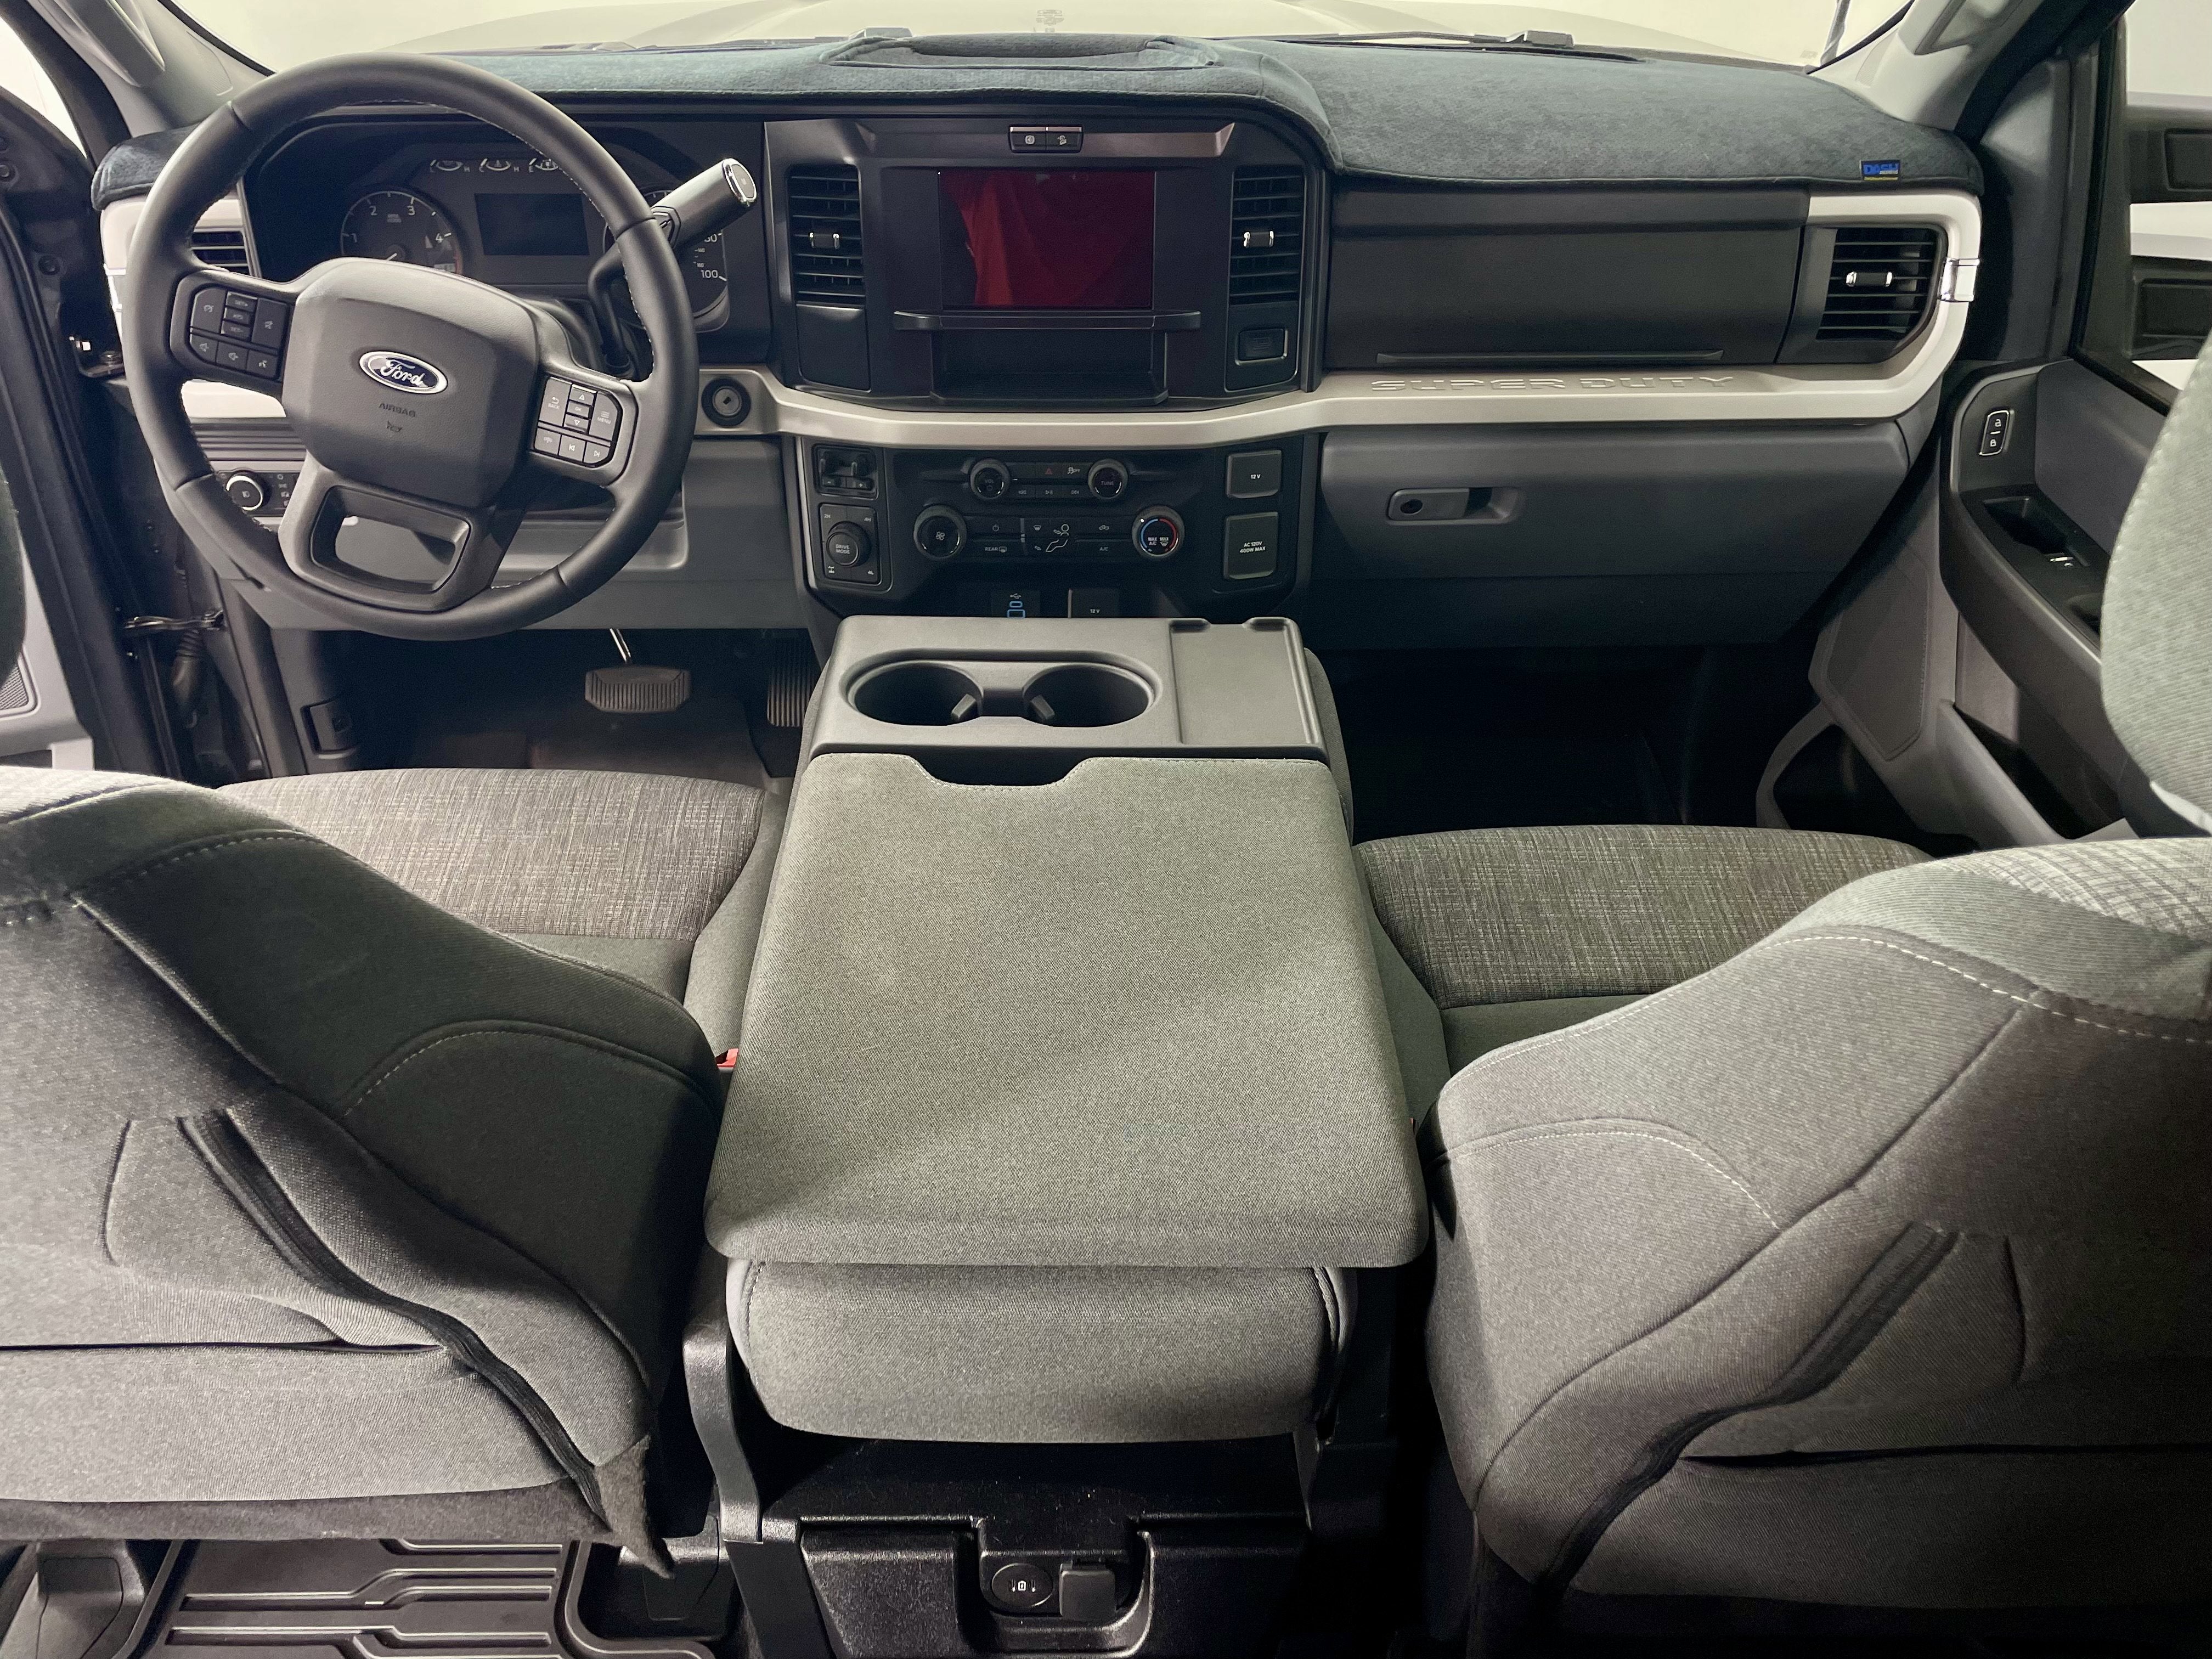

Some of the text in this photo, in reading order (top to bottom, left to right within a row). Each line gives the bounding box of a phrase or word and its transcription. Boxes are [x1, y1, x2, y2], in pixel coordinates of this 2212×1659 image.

[369, 206, 377, 216] 2
[407, 205, 415, 216] 3
[352, 233, 357, 242] 1
[436, 233, 443, 243] 4
[701, 269, 718, 279] 100
[380, 359, 426, 386] Ford
[1371, 376, 1734, 391] SUPER DUTY
[379, 403, 416, 417] AIRBAG
